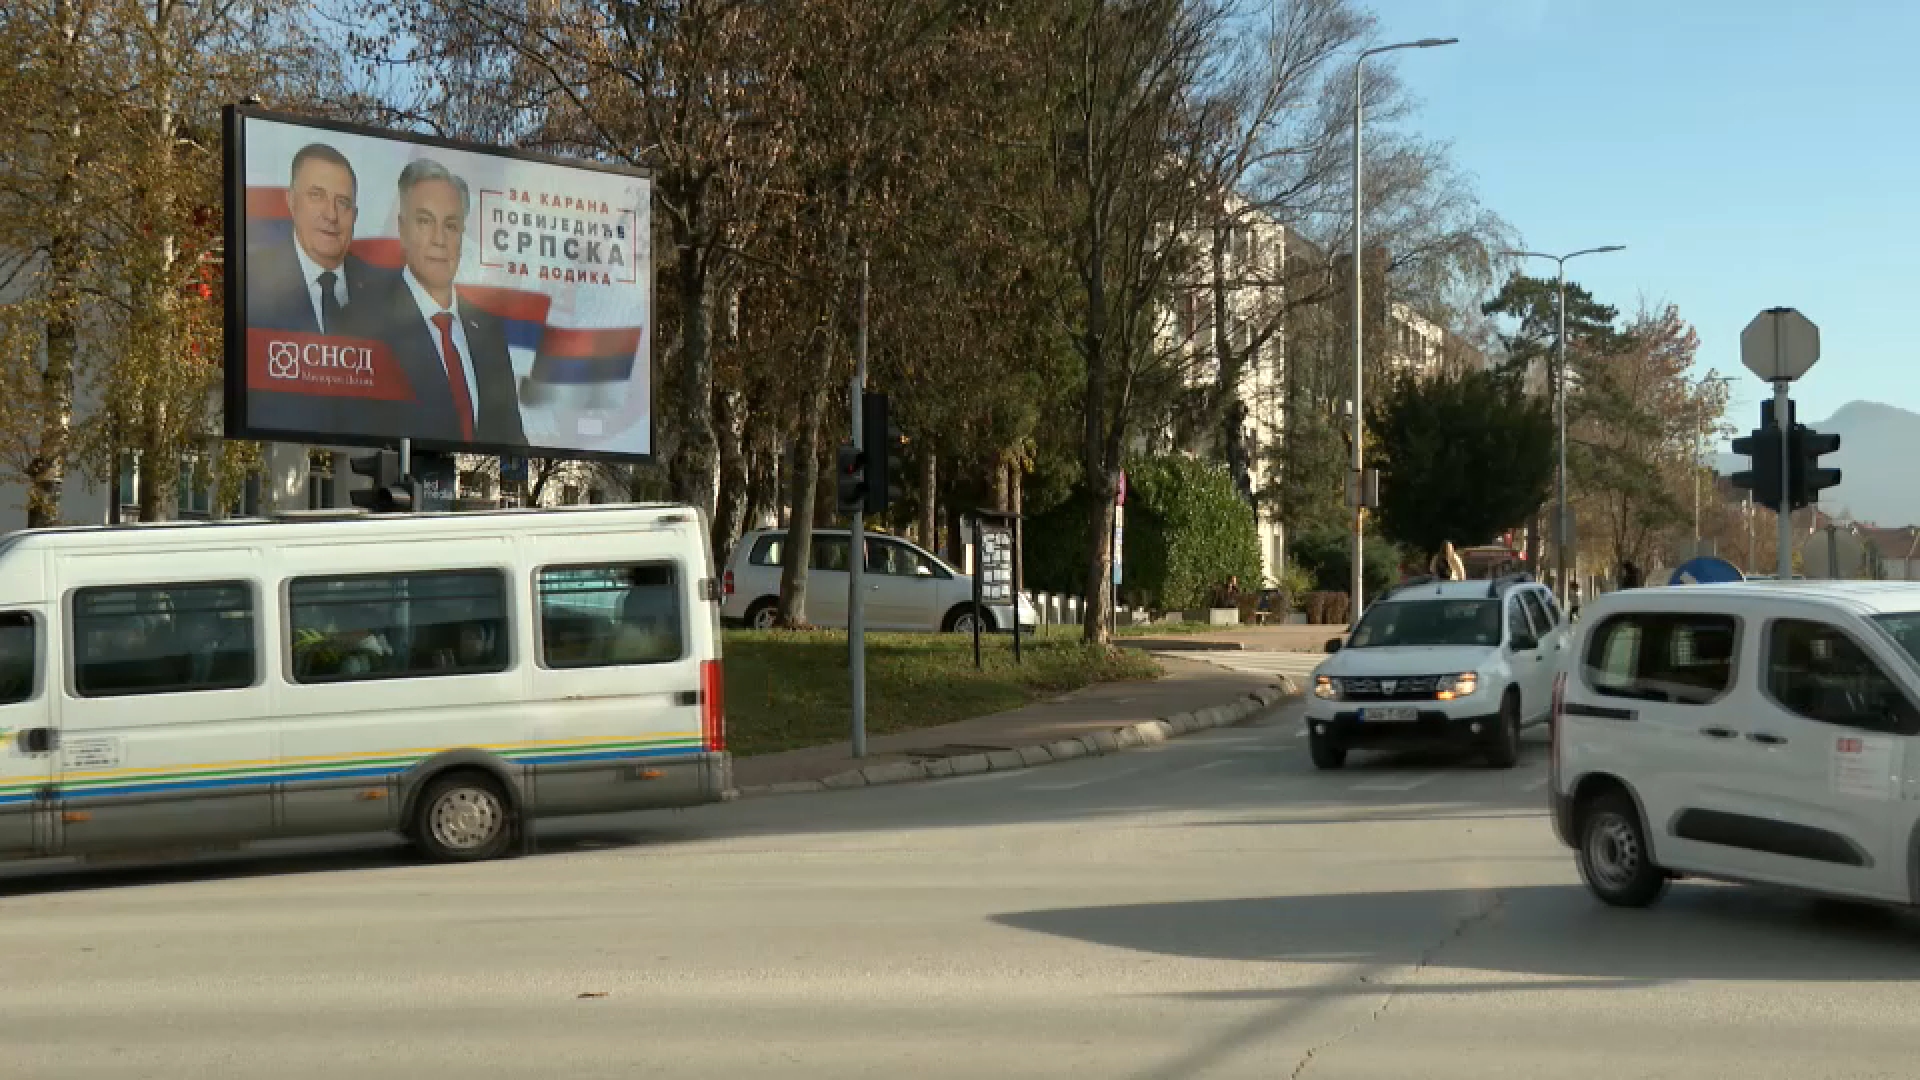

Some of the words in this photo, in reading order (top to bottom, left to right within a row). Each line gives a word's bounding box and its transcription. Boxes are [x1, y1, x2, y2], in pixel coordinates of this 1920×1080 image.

[510, 188, 530, 203] ЗА
[540, 193, 609, 214] КАРАНА
[493, 229, 624, 266] СРПСКА
[508, 262, 528, 276] ЗА
[539, 266, 611, 286] ДОДИКА
[303, 344, 374, 375] СНСД
